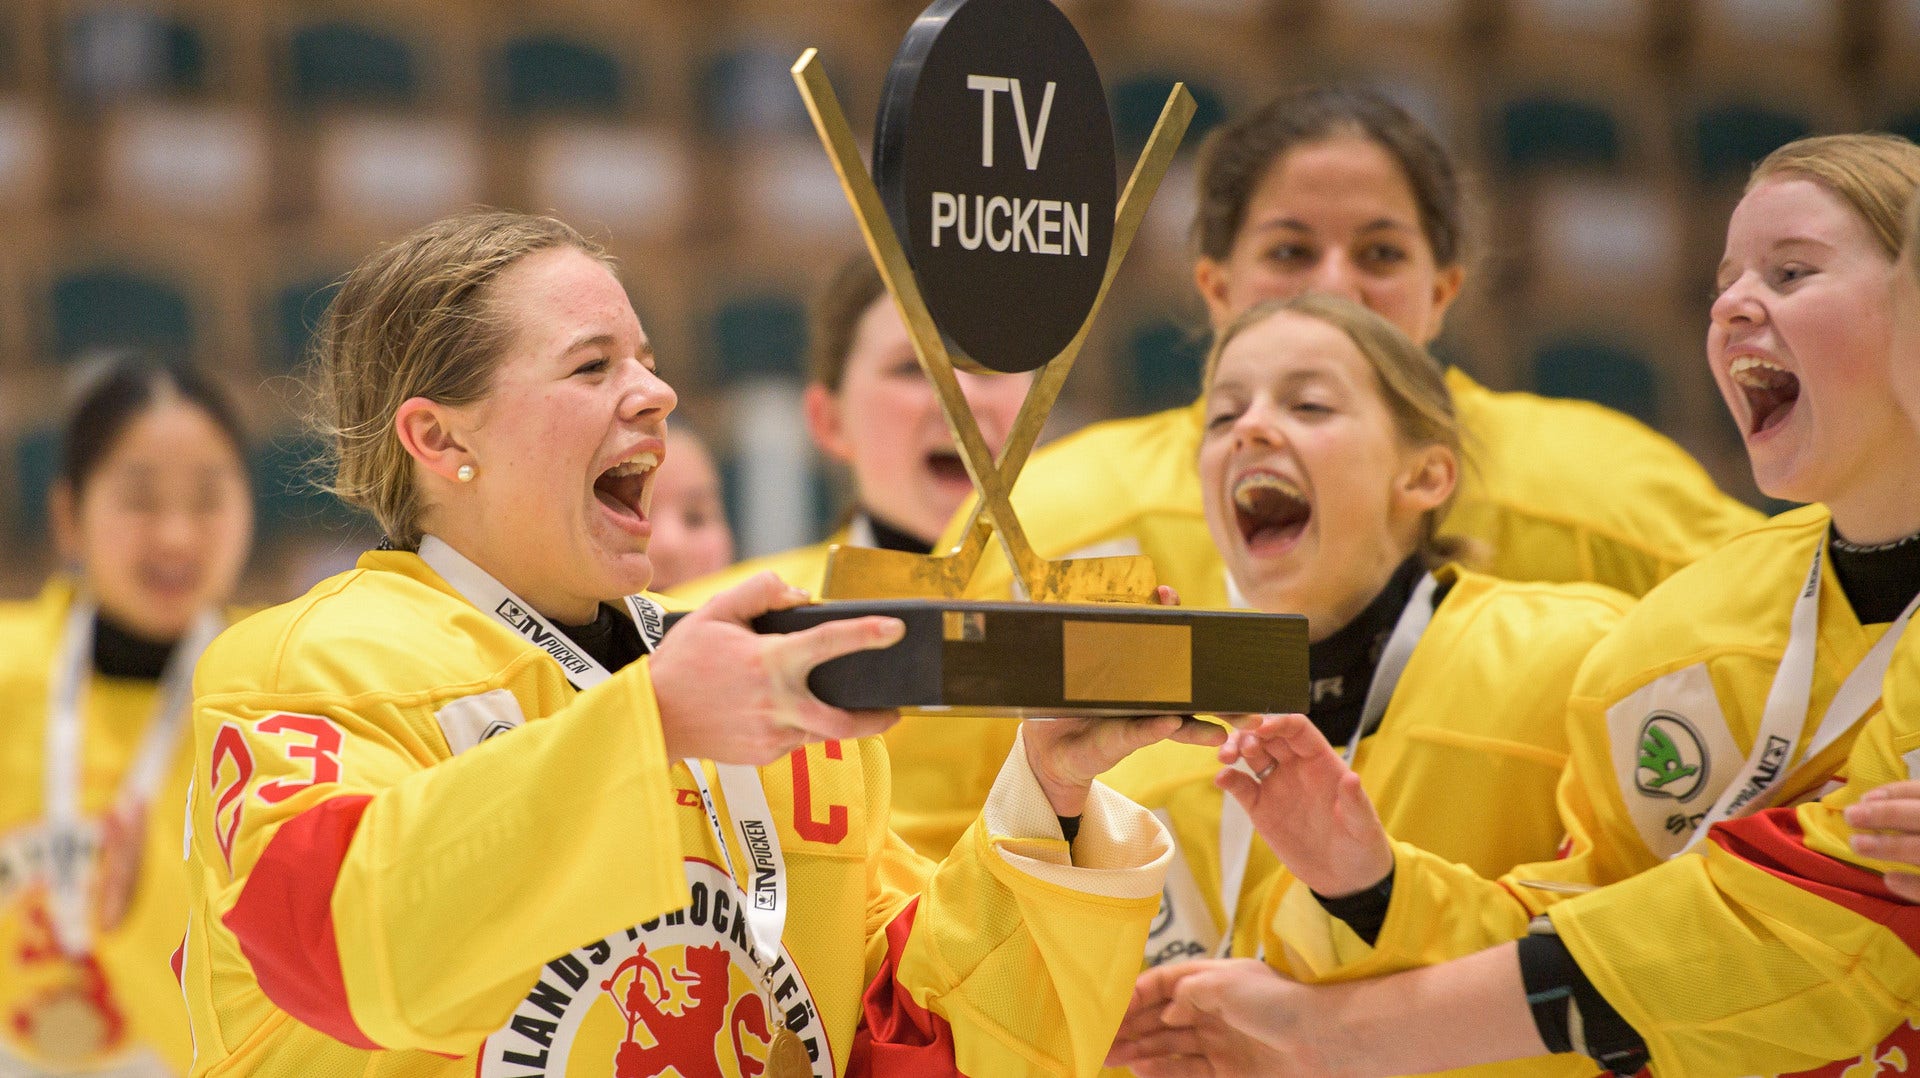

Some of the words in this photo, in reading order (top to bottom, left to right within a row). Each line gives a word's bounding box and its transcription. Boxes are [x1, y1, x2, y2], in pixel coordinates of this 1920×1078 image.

[967, 74, 1056, 170] TV
[931, 191, 1088, 256] PUCKEN
[211, 712, 343, 881] 23
[790, 738, 848, 845] C
[502, 938, 611, 1078] LANDS
